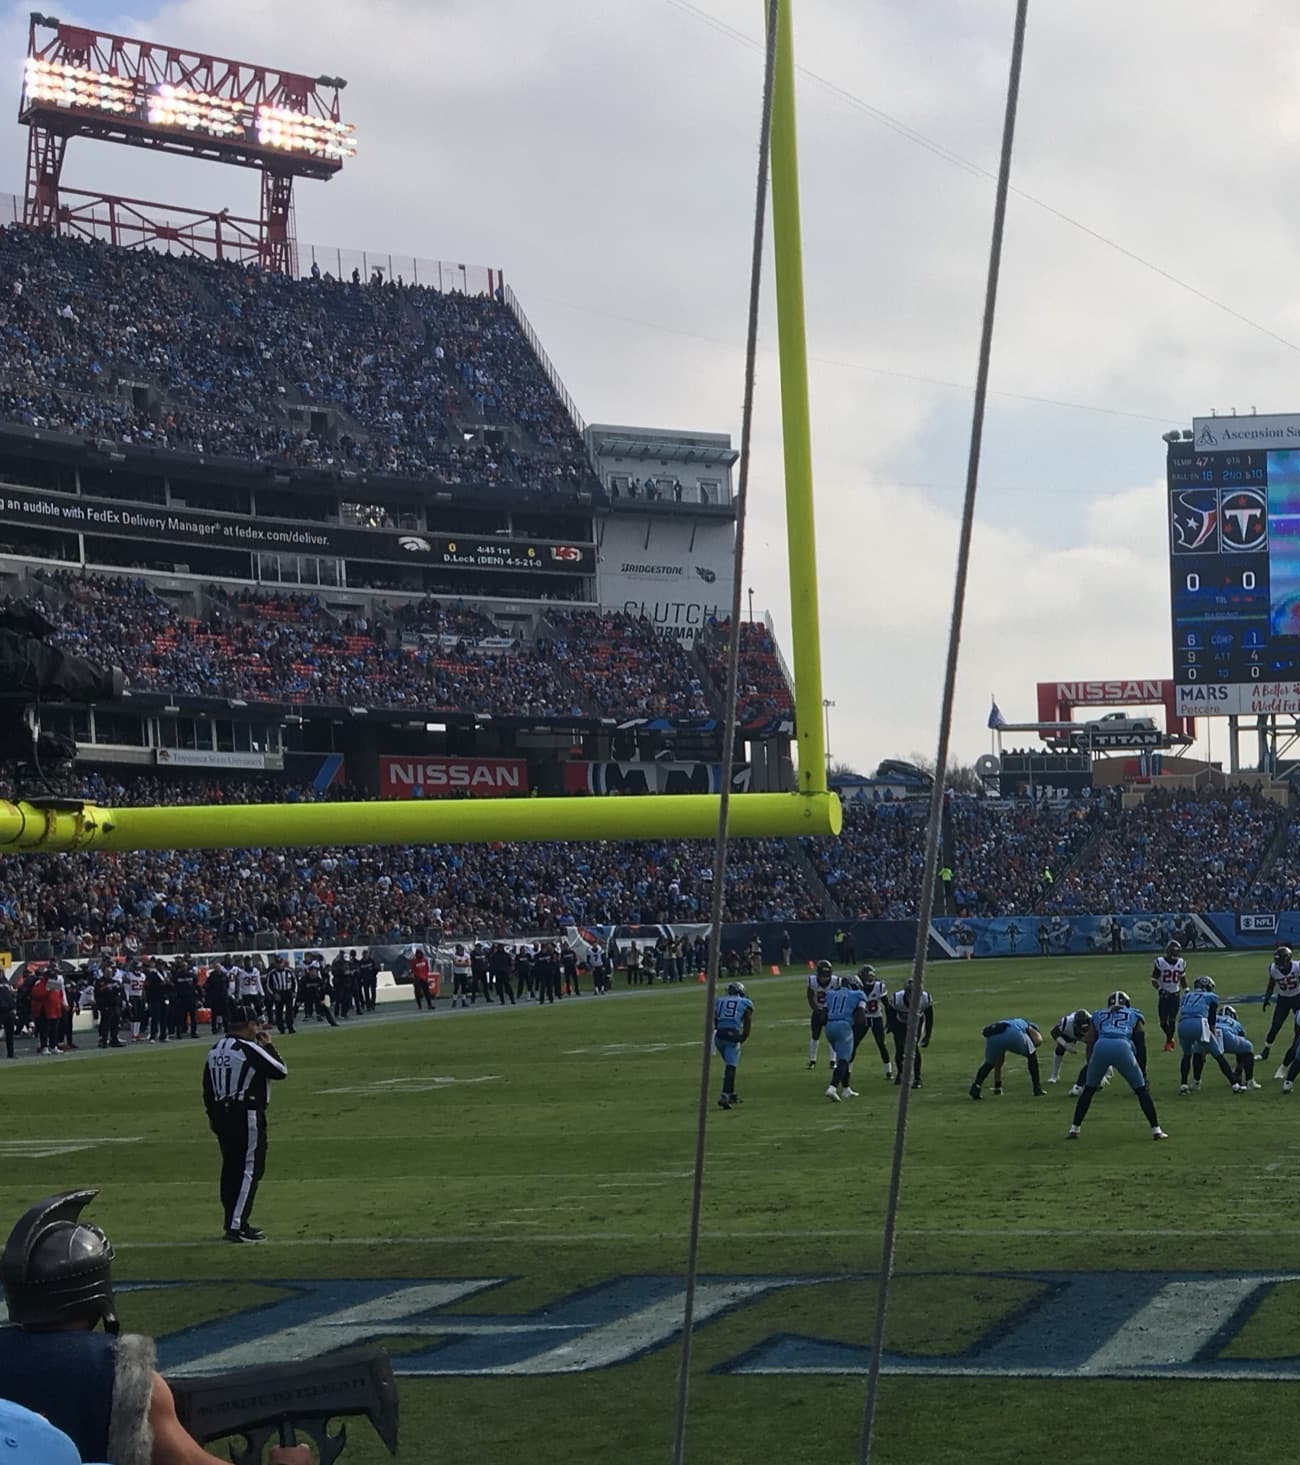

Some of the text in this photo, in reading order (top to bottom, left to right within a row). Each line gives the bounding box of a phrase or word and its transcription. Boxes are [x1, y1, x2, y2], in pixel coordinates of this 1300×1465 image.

[1222, 427, 1284, 440] Ascension
[7, 500, 21, 510] an
[23, 501, 60, 517] audible
[62, 506, 85, 519] with
[87, 508, 120, 524] FedEx
[122, 512, 166, 531] Delivery
[224, 526, 234, 536] at
[235, 526, 330, 546] fedex.com/deliver.
[449, 543, 457, 552] 0
[528, 548, 536, 558] 6
[477, 555, 504, 566] (DEN)
[621, 563, 685, 575] BRIDGESTONE
[1187, 571, 1256, 591] 0 0
[624, 601, 717, 624] CLUTCH
[1187, 634, 1196, 646] 6
[1187, 651, 1196, 663] 9
[1251, 650, 1259, 661] 4
[1188, 668, 1197, 680] 0
[1251, 666, 1260, 678] 0
[1057, 681, 1162, 700] NISSAN
[1181, 686, 1229, 701] MARS
[1096, 735, 1157, 744] TITAN
[390, 763, 519, 786] NISSAN
[1255, 914, 1272, 926] NFL
[717, 1000, 738, 1018] 19
[831, 997, 849, 1014] 11
[212, 1056, 231, 1067] 102
